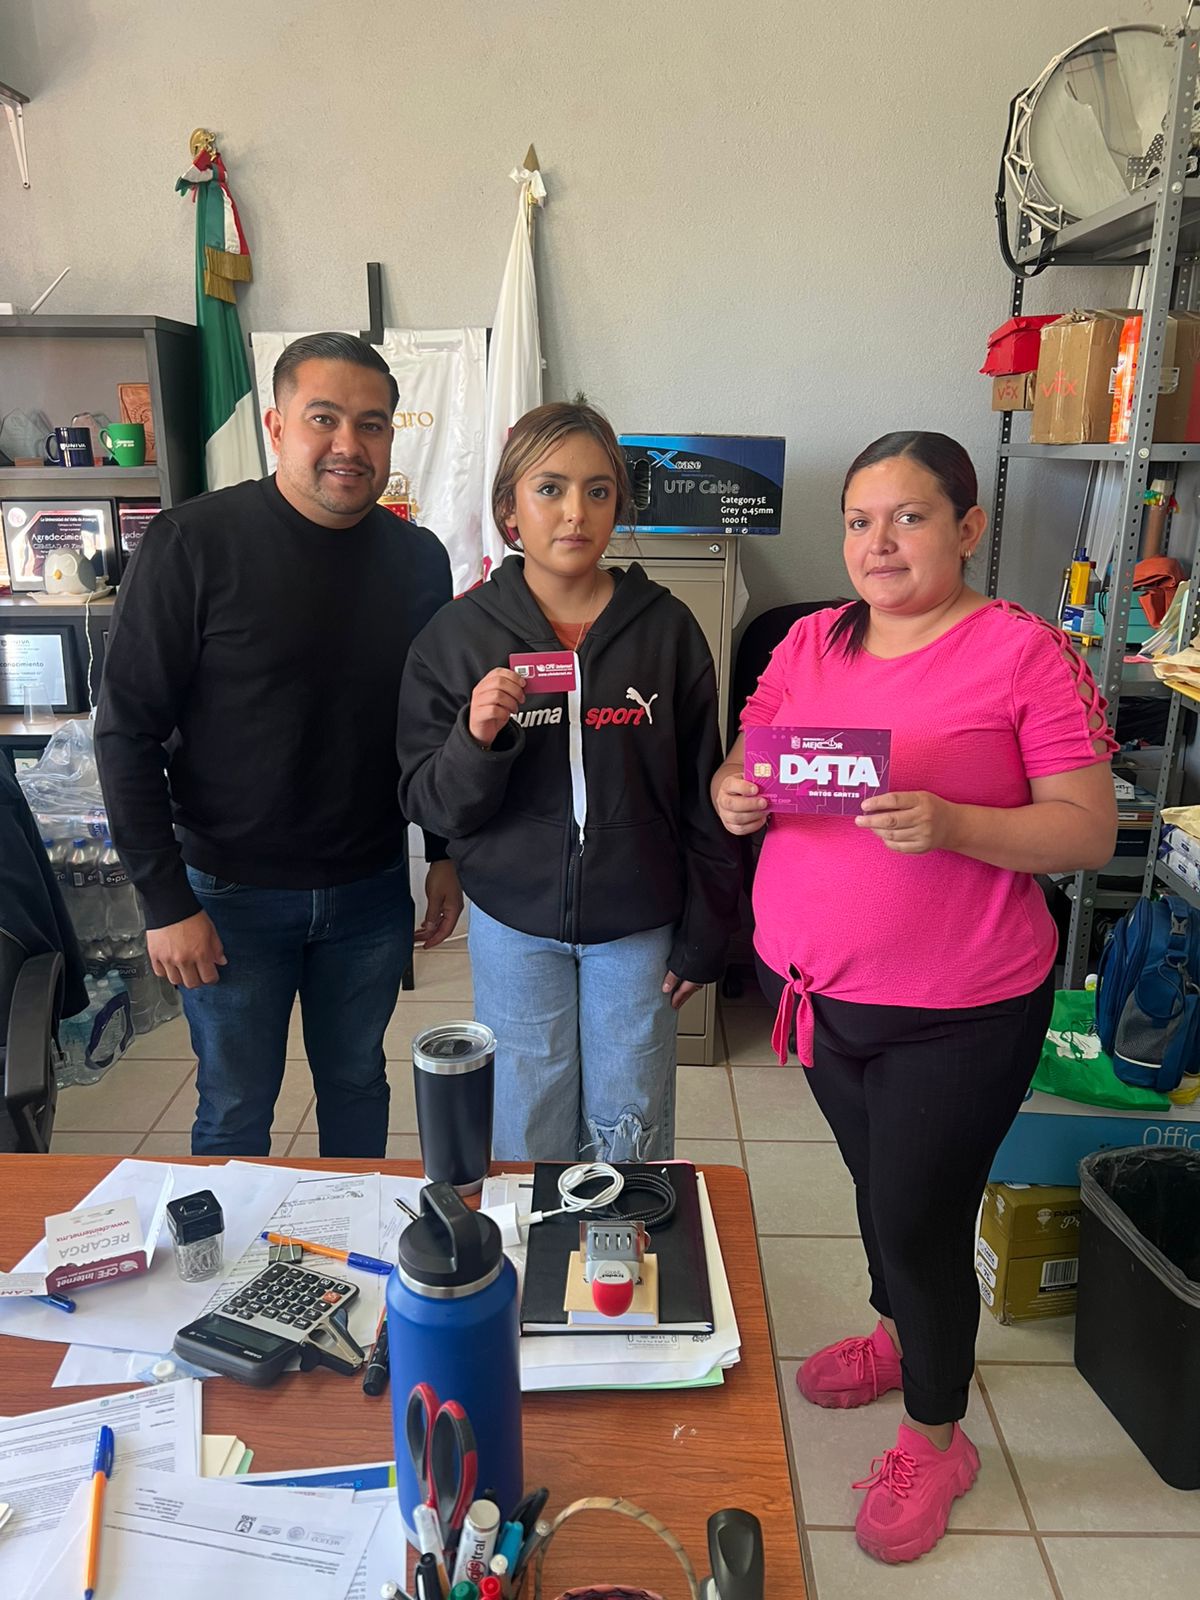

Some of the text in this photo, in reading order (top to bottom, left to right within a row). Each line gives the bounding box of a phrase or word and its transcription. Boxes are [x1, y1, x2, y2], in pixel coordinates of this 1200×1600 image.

[392, 410, 435, 429] aro
[663, 479, 740, 494] UTP Cable
[720, 496, 767, 506] Category 5E
[720, 506, 740, 516] Grey
[740, 516, 748, 524] ft
[32, 533, 84, 543] Agradecimien
[584, 705, 646, 730] sport
[780, 754, 880, 788] D4TA
[58, 1232, 130, 1259] RECARGA
[56, 1273, 95, 1288] Internet
[97, 1267, 119, 1280] CFE
